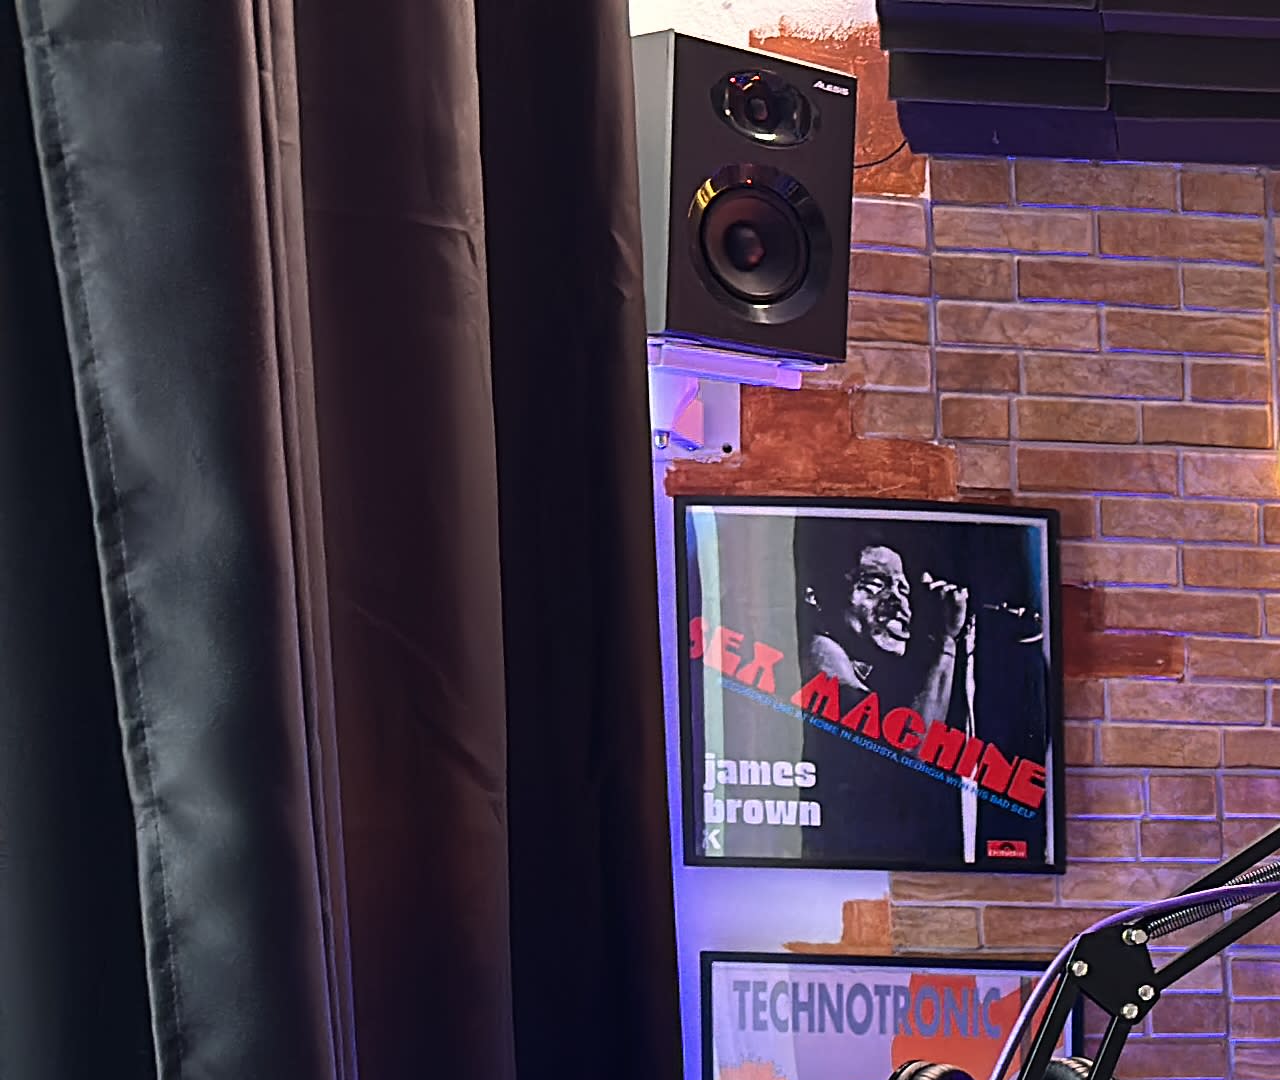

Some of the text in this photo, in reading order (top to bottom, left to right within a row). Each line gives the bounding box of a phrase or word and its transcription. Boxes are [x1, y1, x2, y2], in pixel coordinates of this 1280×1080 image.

[689, 616, 1046, 809] SEX MACHINE
[703, 753, 816, 790] james
[703, 792, 821, 826] brown
[988, 792, 1011, 808] BAD
[1010, 802, 1037, 820] SELF
[732, 980, 1002, 1040] TECHNOTRONIC
